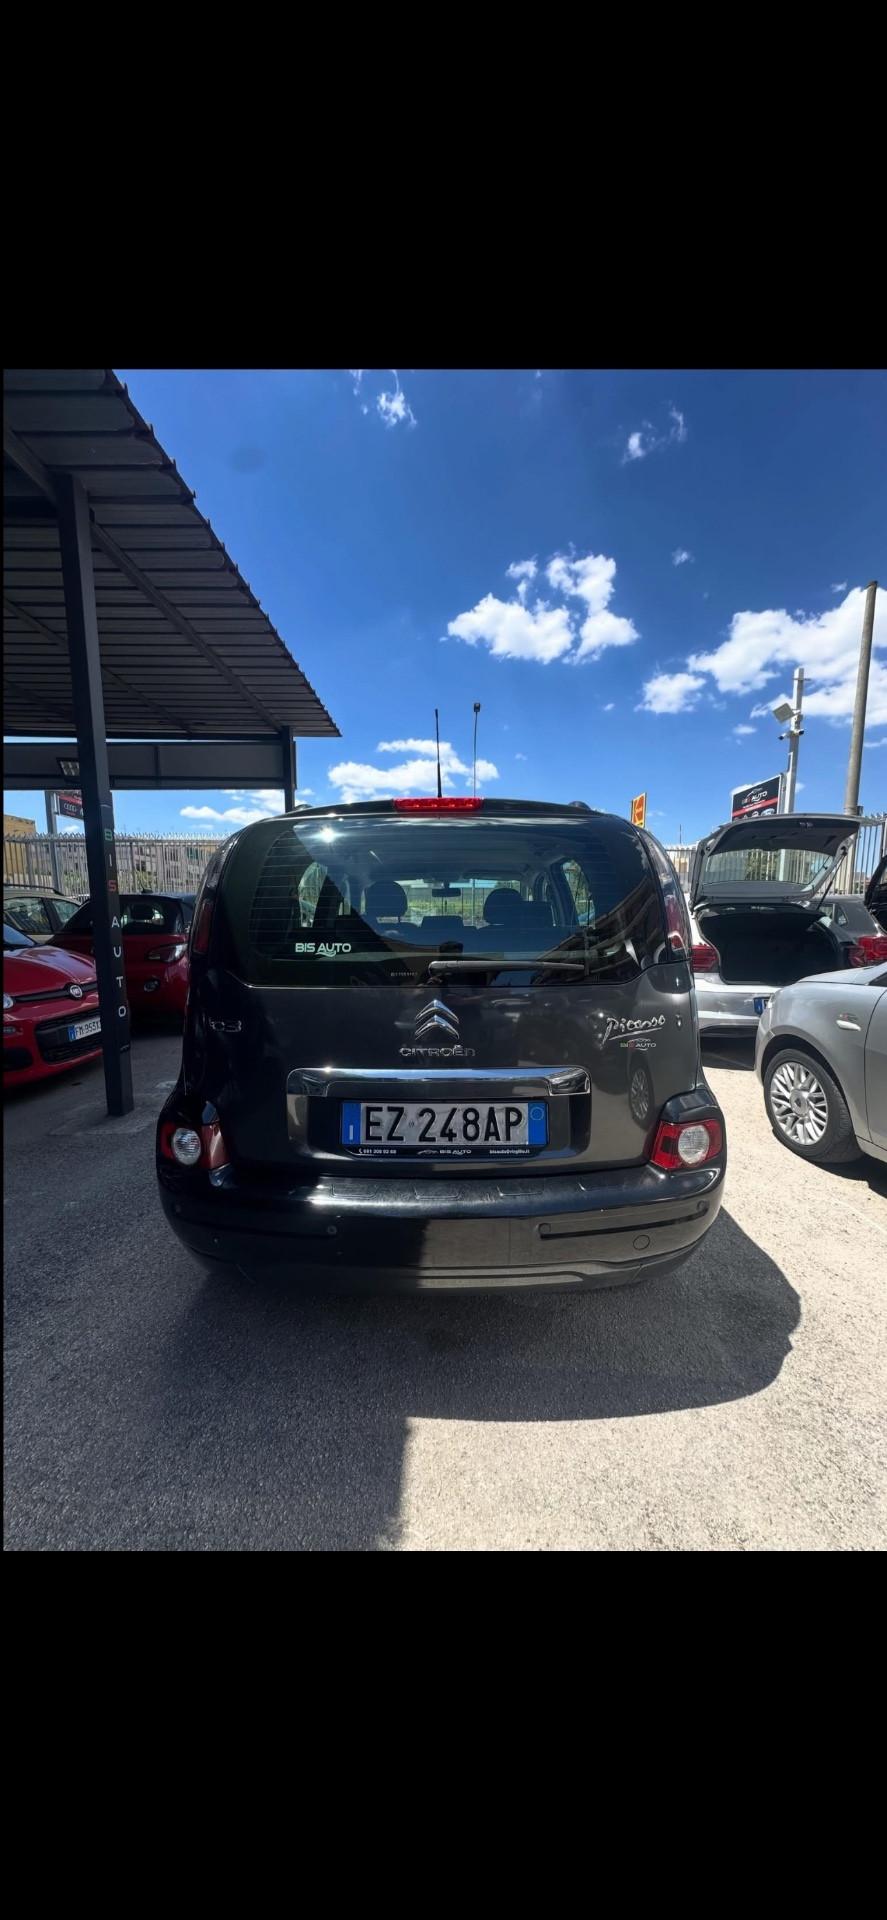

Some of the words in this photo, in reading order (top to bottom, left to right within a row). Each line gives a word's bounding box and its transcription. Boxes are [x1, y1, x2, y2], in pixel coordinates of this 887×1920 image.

[295, 942, 316, 953] BIS
[316, 942, 352, 954] AUTO
[111, 915, 127, 1017] AUTO
[602, 1014, 666, 1046] Picasso
[365, 1106, 405, 1142] EZ
[418, 1106, 523, 1142] 248AP
